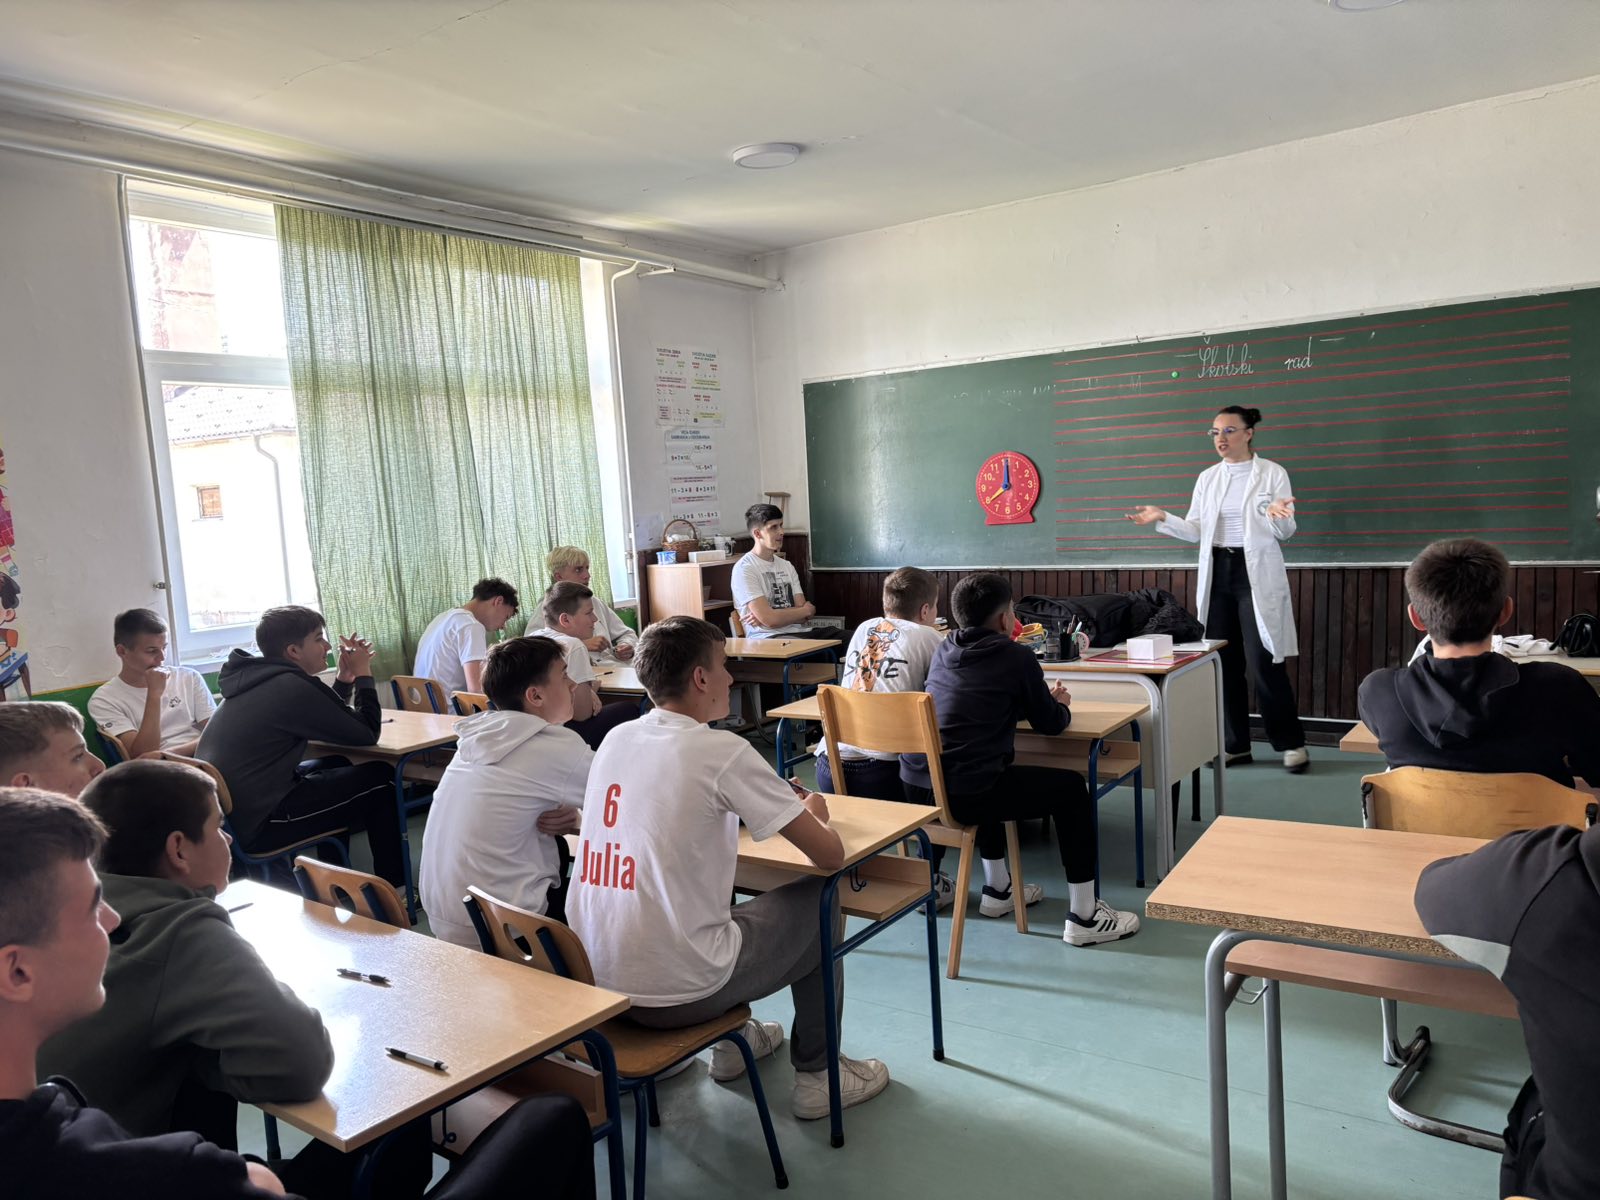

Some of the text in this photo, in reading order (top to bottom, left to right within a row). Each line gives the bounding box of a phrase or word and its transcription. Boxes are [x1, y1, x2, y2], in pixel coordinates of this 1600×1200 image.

[1284, 336, 1313, 370] rad
[990, 463, 998, 471] 11
[1015, 461, 1019, 469] 1
[983, 472, 992, 481] 10
[1024, 469, 1030, 478] 2
[981, 484, 986, 492] 9
[1027, 480, 1033, 488] 3
[1024, 493, 1029, 501] 4
[994, 504, 999, 512] 7
[1005, 506, 1010, 514] 6
[1016, 502, 1022, 511] 5
[603, 783, 621, 828] 6
[580, 839, 636, 891] Julia
